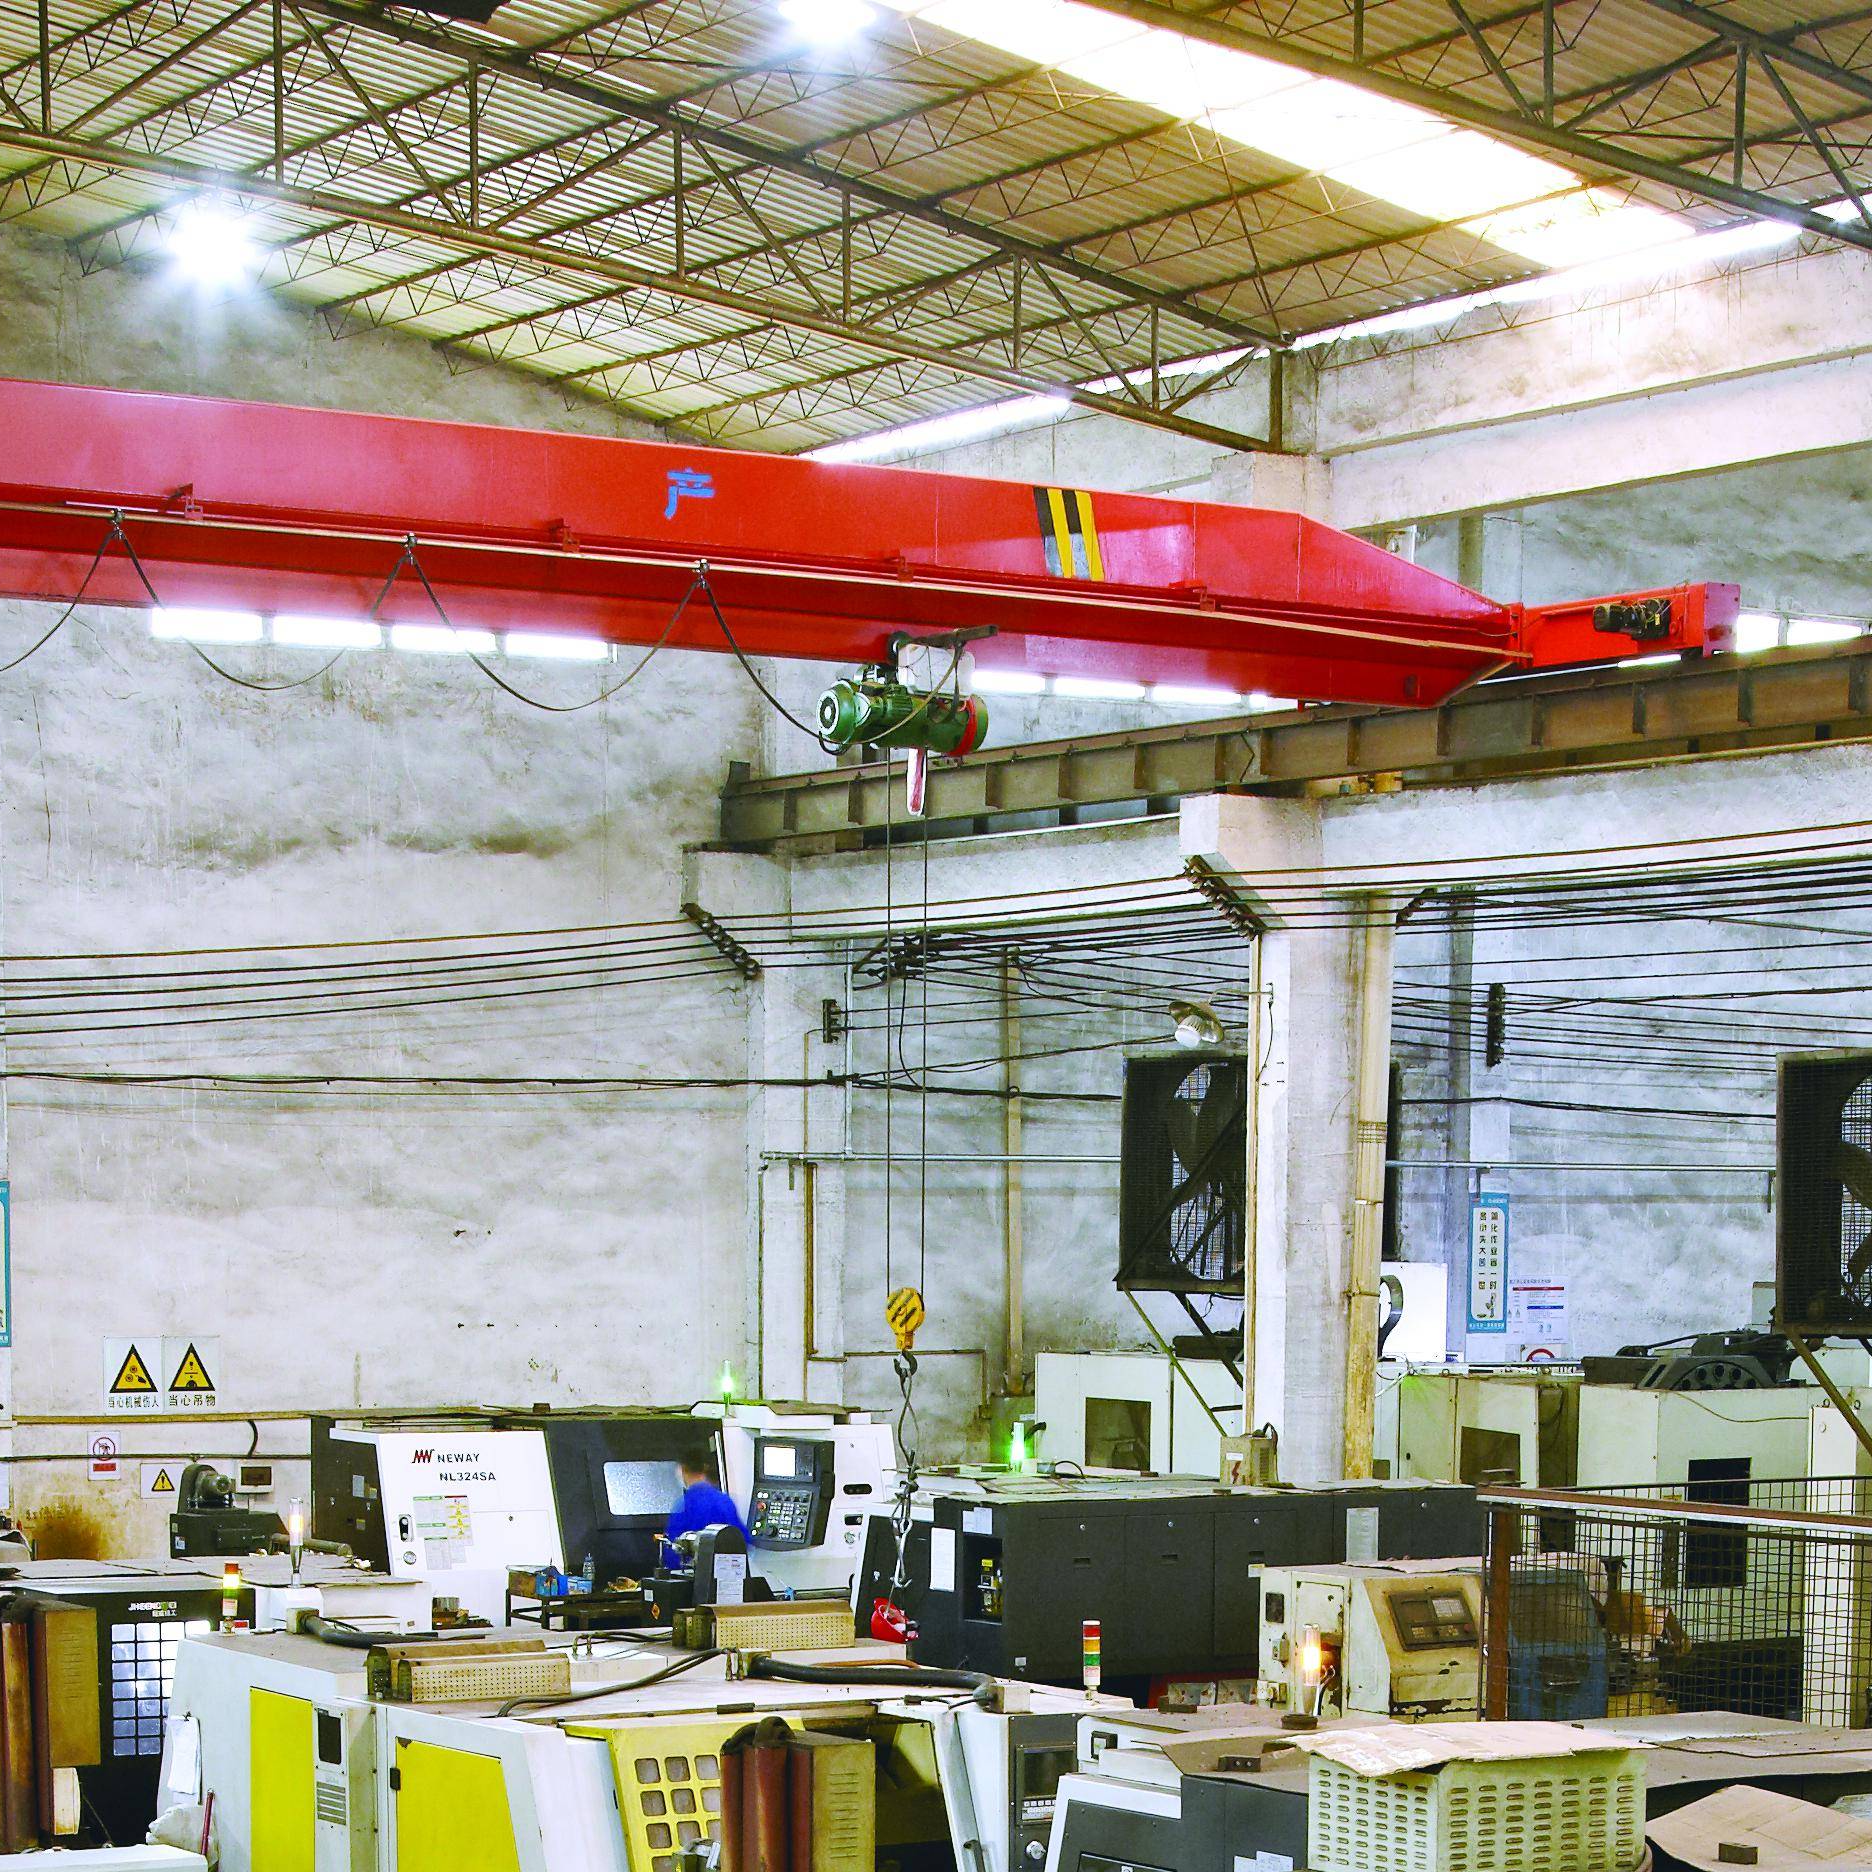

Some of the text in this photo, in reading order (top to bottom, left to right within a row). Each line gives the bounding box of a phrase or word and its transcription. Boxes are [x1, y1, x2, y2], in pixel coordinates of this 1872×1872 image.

[663, 467, 717, 520] 产
[108, 1395, 160, 1409] 当心机械伤人
[169, 1394, 216, 1408] 当心吊物
[437, 1453, 480, 1464] NEWAY
[439, 1471, 497, 1483] NL324SA
